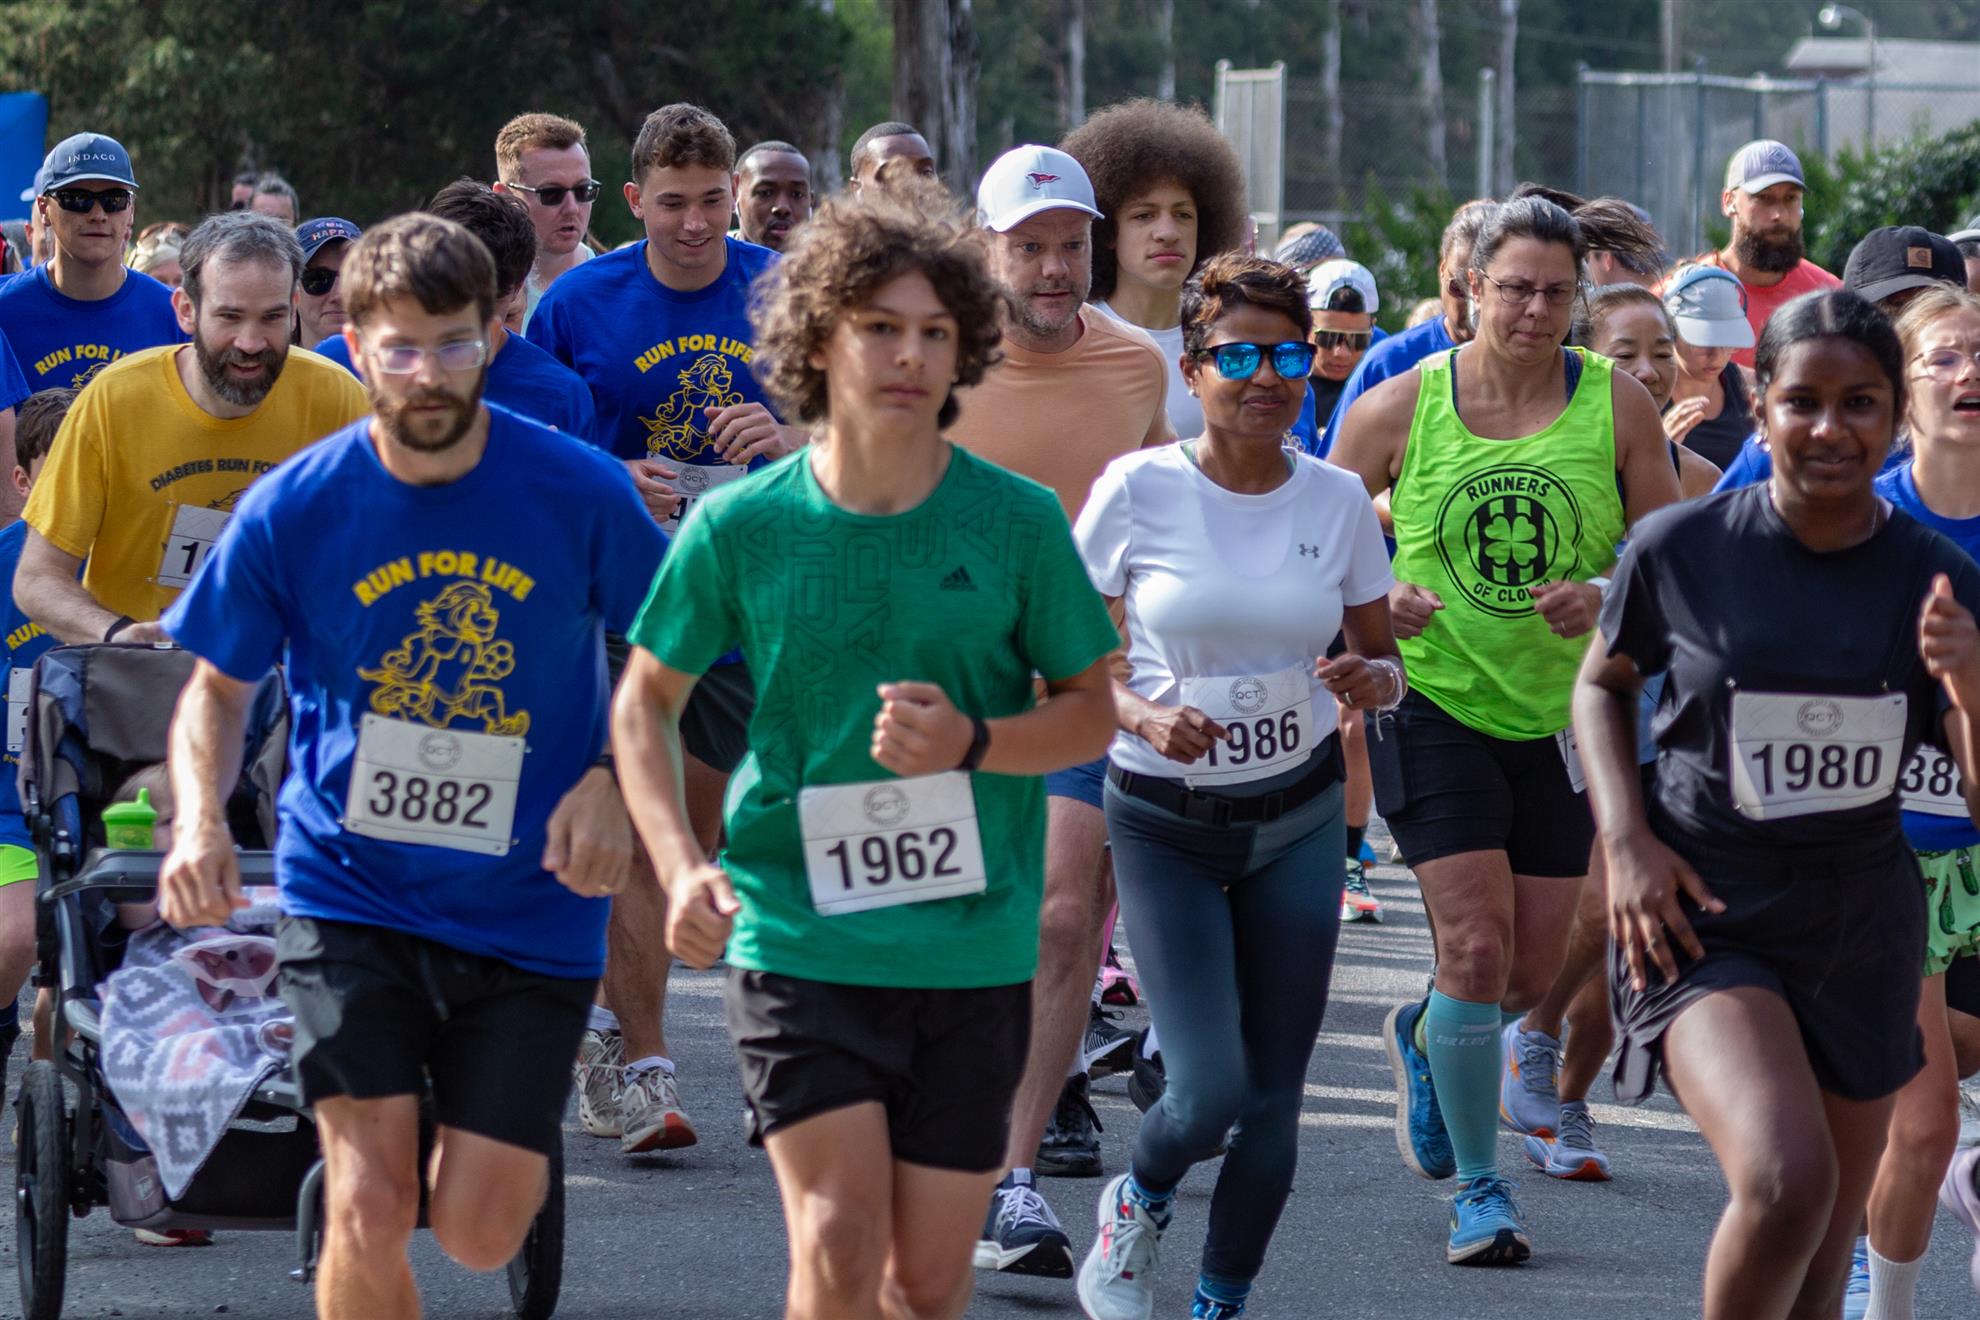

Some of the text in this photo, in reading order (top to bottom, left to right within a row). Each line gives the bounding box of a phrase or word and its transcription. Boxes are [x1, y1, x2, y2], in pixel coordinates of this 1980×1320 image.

[68, 152, 116, 163] INDACO
[34, 347, 72, 376] RUN
[75, 344, 109, 361] FOR
[634, 334, 753, 374] RUN FOR LIFE
[150, 459, 279, 492] DIABETES RUN FO
[1466, 476, 1550, 502] RUNNERS
[353, 550, 536, 608] RUN FOR LIFE
[1473, 582, 1493, 598] OF
[6, 622, 47, 650] RUN
[1235, 689, 1260, 700] QCT
[1751, 743, 1883, 797] 1980
[1901, 754, 1967, 798] 38
[369, 771, 493, 829] 3882
[826, 827, 962, 890] 1962
